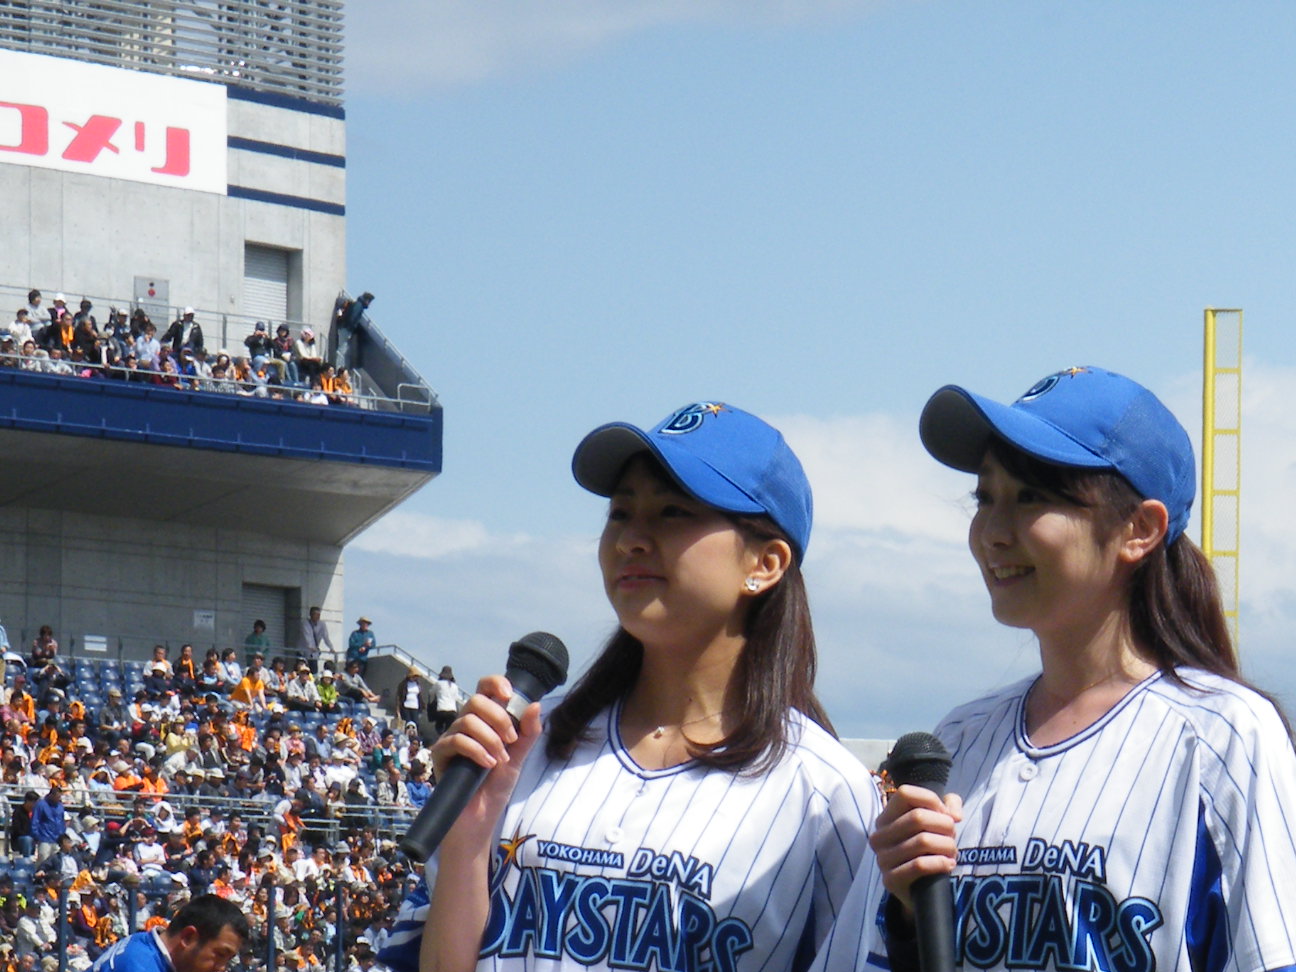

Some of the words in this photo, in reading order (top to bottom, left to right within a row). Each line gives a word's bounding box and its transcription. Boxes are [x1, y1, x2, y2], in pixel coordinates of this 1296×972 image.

[0, 102, 190, 177] コメリ
[537, 840, 624, 869] YOKOHAMA
[626, 848, 714, 900] DeNA
[956, 846, 1017, 865] OKOHAMA
[1021, 837, 1107, 884] DeNA
